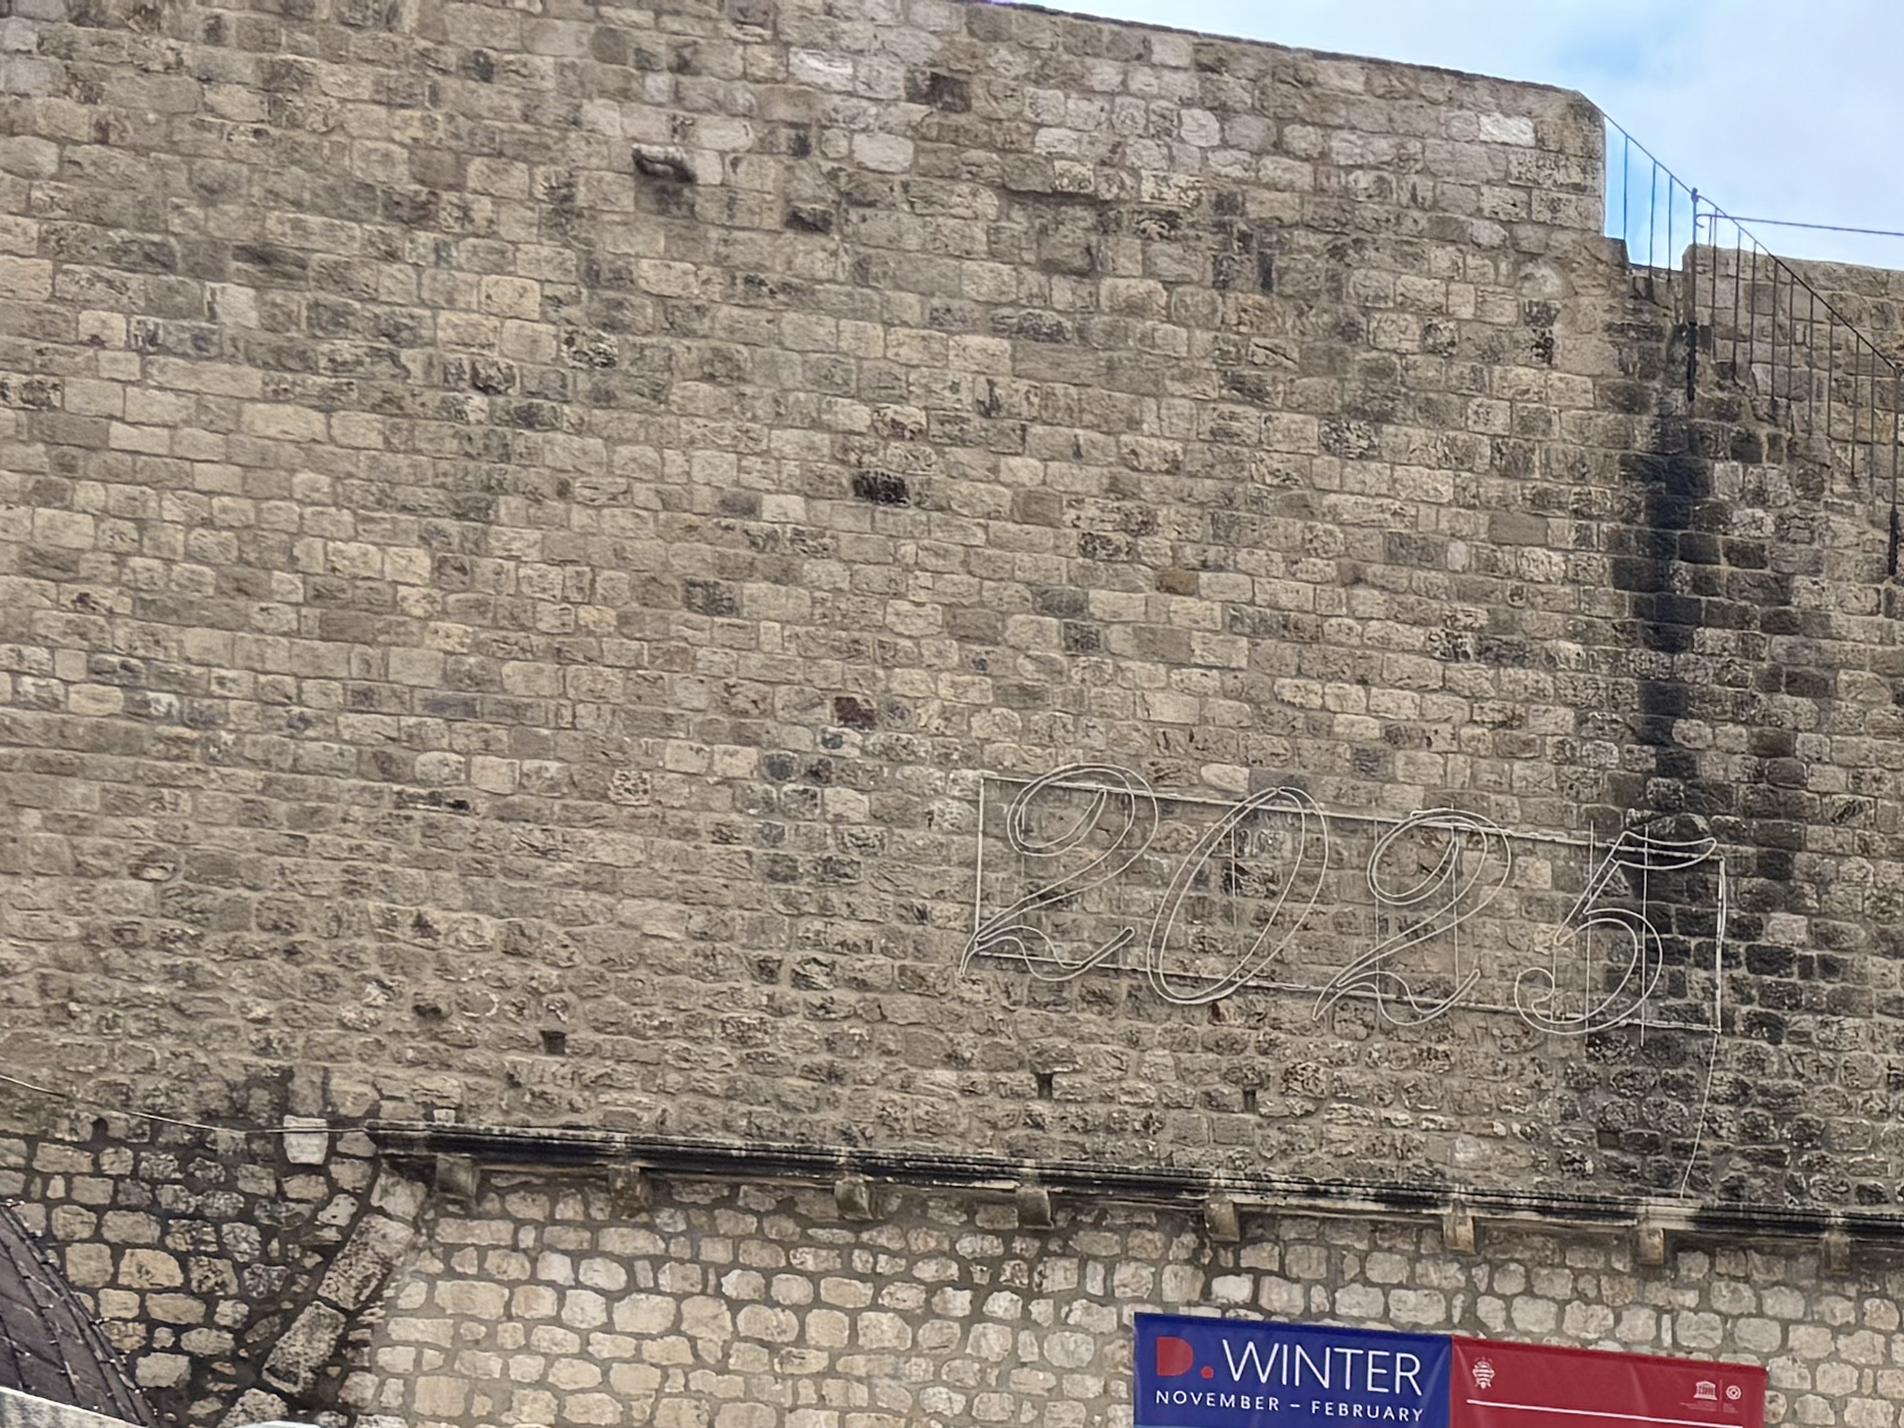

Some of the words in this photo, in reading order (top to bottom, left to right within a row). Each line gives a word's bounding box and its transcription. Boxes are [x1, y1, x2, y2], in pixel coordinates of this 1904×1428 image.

[959, 763, 1718, 1035] 2025
[1222, 1338, 1423, 1396] WINTER
[1156, 1390, 1280, 1412] NOVEMBER
[1311, 1401, 1424, 1422] FEBRUARY
